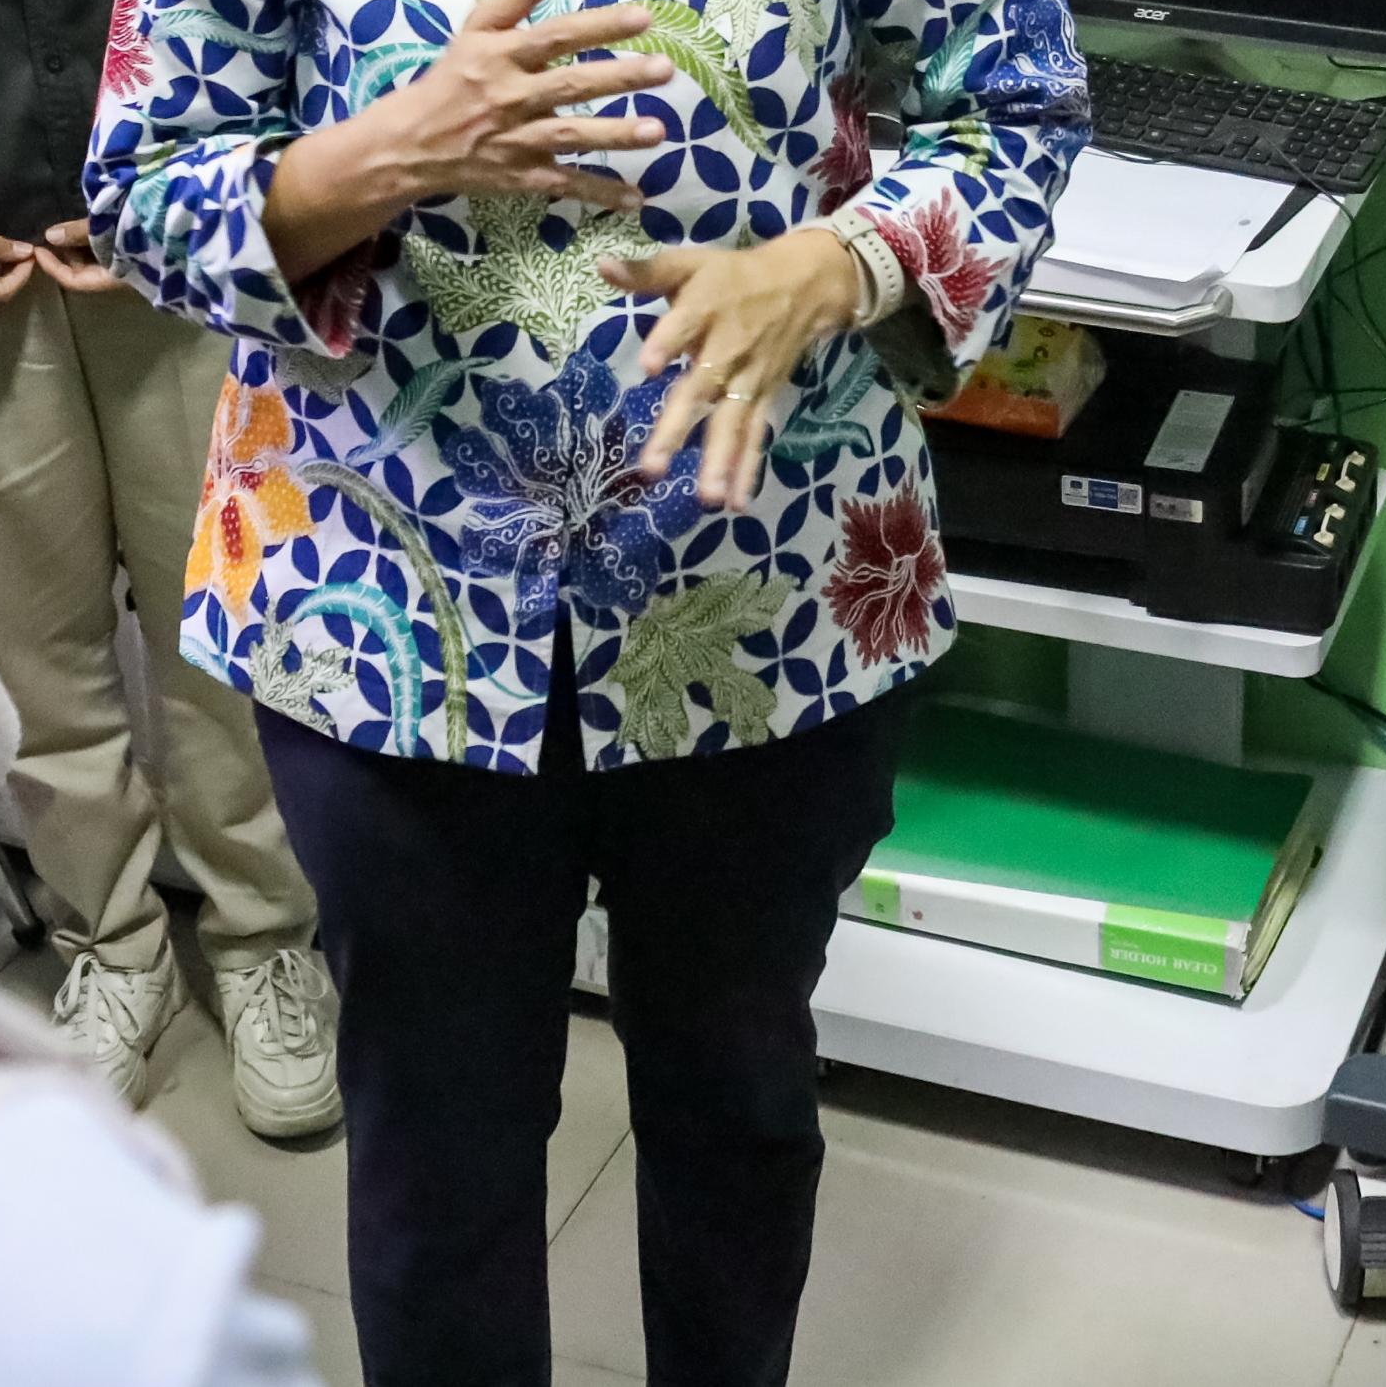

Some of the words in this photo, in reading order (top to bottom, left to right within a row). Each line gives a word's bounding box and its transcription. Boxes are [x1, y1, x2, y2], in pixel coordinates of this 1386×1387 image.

[1133, 7, 1170, 21] acer
[1109, 948, 1168, 967] HOLDER
[1172, 957, 1219, 975] CLEAR
